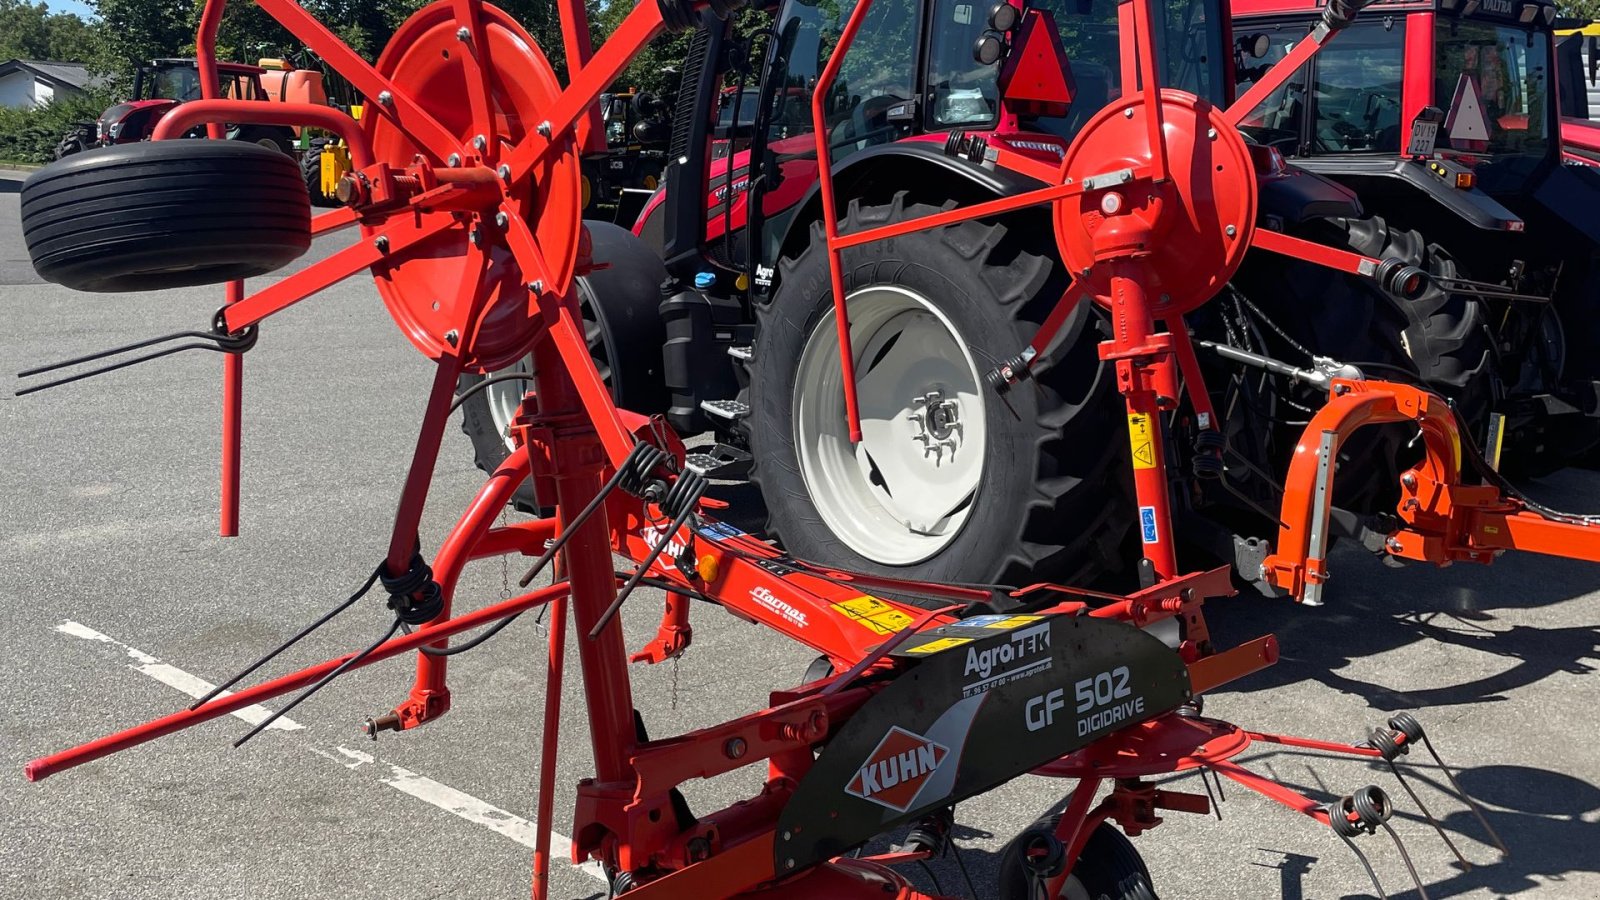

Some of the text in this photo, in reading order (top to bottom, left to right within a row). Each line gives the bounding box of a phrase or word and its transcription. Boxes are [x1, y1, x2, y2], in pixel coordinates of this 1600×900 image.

[1483, 0, 1512, 14] VALTRA
[1414, 124, 1426, 137] DV
[1414, 139, 1430, 152] 227
[963, 622, 1051, 678] AgroTEK
[1025, 666, 1132, 732] GF 502
[1077, 696, 1145, 737] DIGIDRIVE
[861, 742, 937, 798] KUHN
